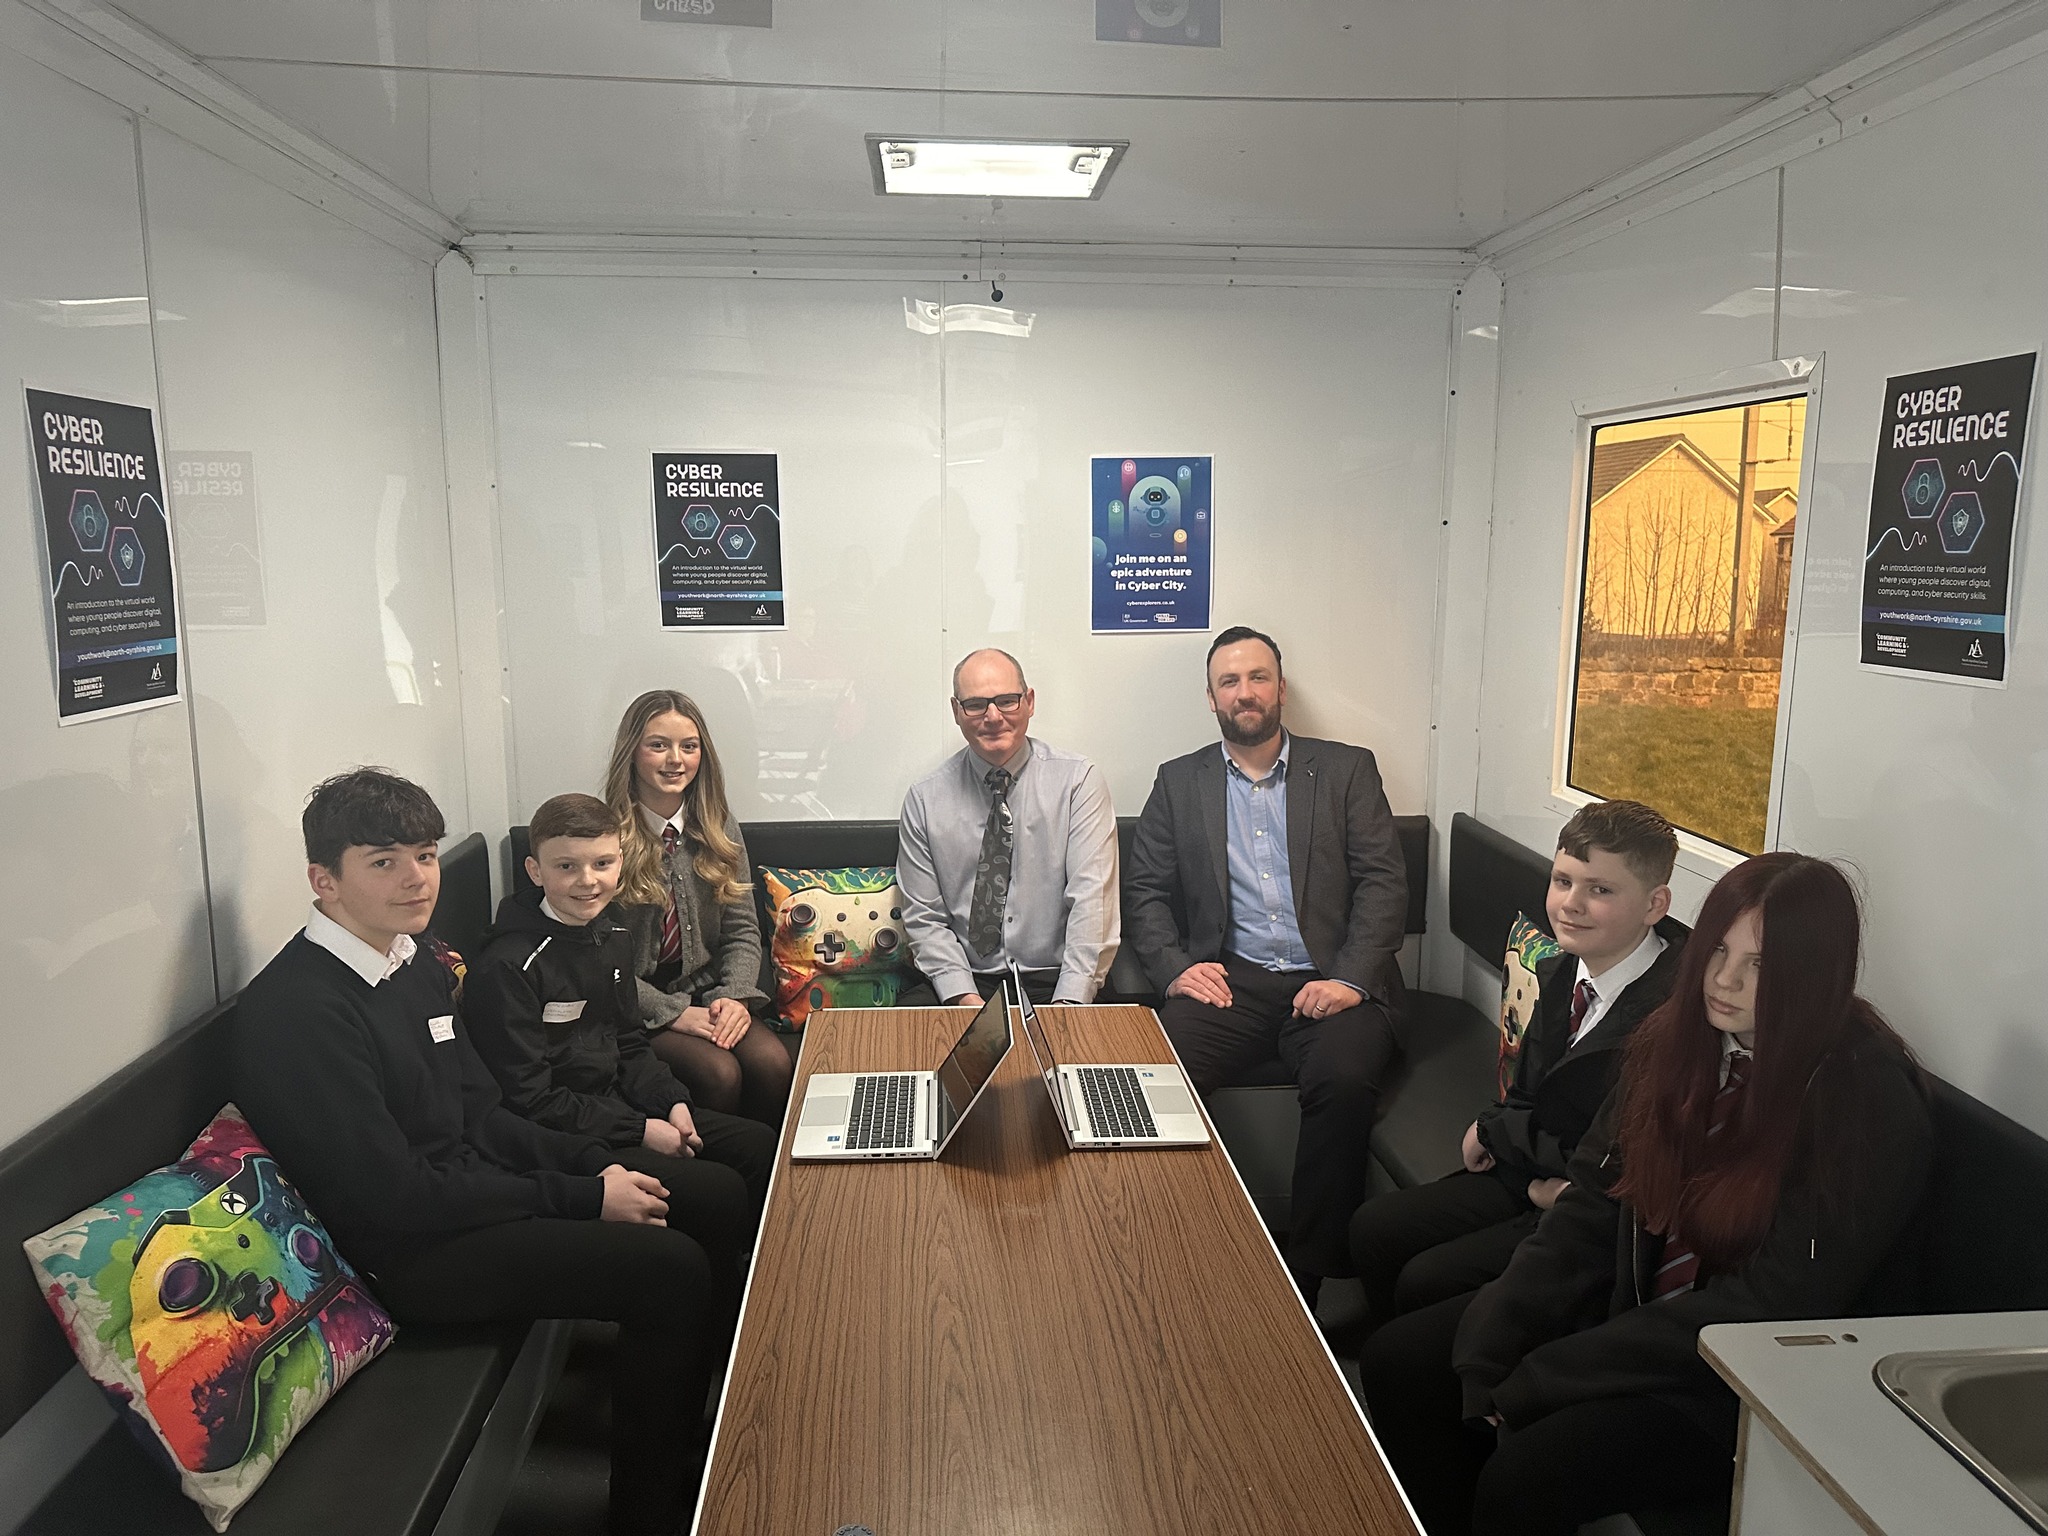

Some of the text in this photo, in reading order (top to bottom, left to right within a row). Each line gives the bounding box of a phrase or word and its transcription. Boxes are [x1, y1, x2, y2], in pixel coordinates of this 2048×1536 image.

[1896, 385, 1962, 418] CYBER
[43, 412, 104, 446] CYBER
[1892, 410, 2010, 448] RESILIENCE
[47, 446, 146, 480] RESILIENCE
[665, 464, 722, 480] CYBER
[666, 482, 764, 498] RESILIENCE
[1114, 554, 1136, 566] Join
[1138, 556, 1156, 564] me
[1110, 567, 1192, 578] epic adventure
[1890, 564, 1926, 572] introduction
[1934, 565, 1944, 573] the
[1946, 566, 1966, 574] virtual
[1968, 566, 1986, 574] world
[1115, 580, 1186, 592] in Cyber City.
[1898, 578, 1916, 586] young
[1918, 578, 1940, 586] people
[1940, 578, 1968, 586] discover
[1968, 579, 1991, 588] digital,
[1878, 588, 1987, 600] computing, and cyber security skills.
[67, 596, 156, 610] An introduction to the virtual world
[68, 614, 86, 622] where
[86, 613, 104, 623] young
[104, 611, 122, 620] people
[123, 610, 144, 618] discover
[1880, 611, 1982, 626] youthwork@north-ayrshire.gov.uk
[101, 624, 112, 633] and
[113, 623, 128, 632] cyber
[128, 621, 148, 630] security
[77, 643, 162, 662] youthwork@north-ayrshire.gov.uk
